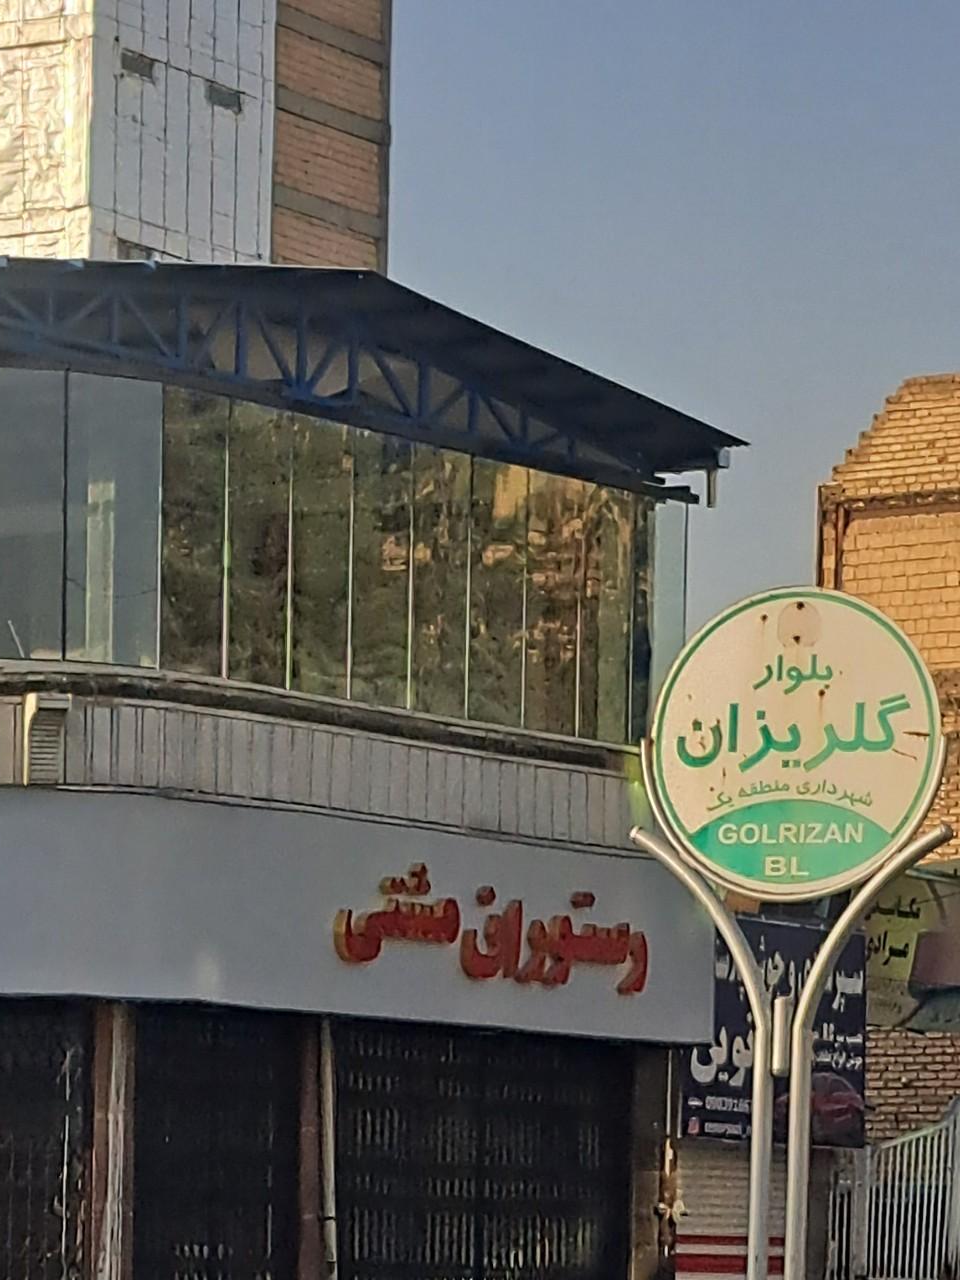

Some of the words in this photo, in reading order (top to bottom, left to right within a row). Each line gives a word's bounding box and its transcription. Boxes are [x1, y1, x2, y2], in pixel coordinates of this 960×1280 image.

[753, 654, 834, 694] بلوار
[676, 693, 911, 772] گلریزان
[706, 791, 733, 812] یک
[738, 780, 790, 798] منطقه
[717, 822, 864, 845] GOLRIZAN
[764, 855, 810, 877] BL
[333, 862, 461, 963] مشتی
[460, 885, 648, 996] رستوران
